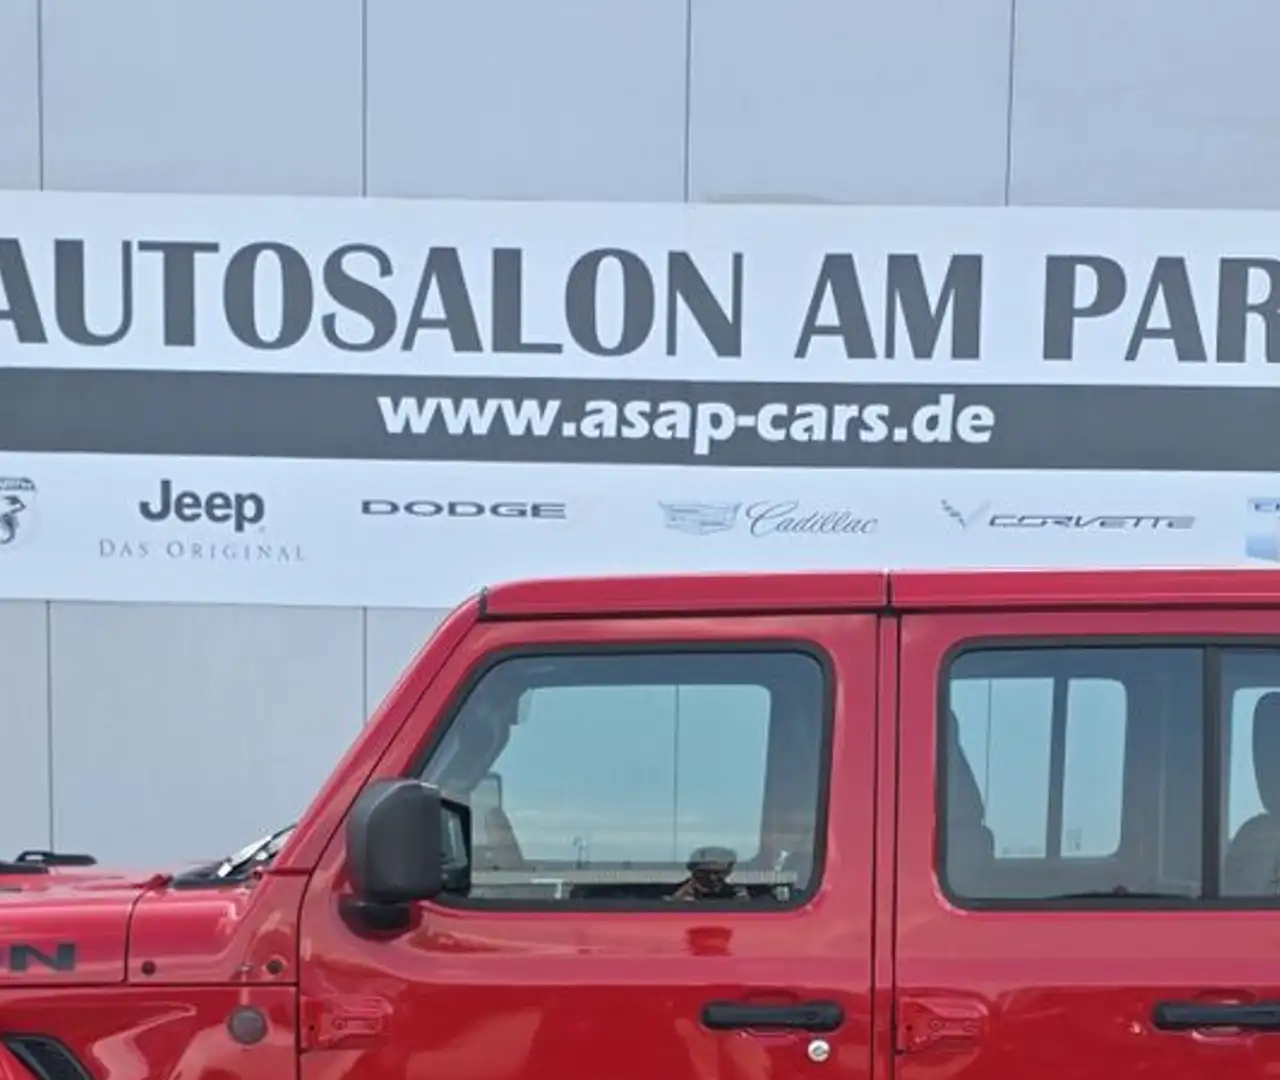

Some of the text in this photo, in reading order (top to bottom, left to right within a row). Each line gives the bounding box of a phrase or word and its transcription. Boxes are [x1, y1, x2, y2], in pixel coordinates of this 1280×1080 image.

[794, 253, 984, 361] AM
[377, 394, 995, 455] www.asap-cars.de
[139, 479, 265, 533] Jeep
[361, 499, 567, 519] DODGE
[745, 500, 879, 537] Cadillac
[988, 514, 1197, 530] CORVETTE
[166, 540, 307, 563] ORIGINAL
